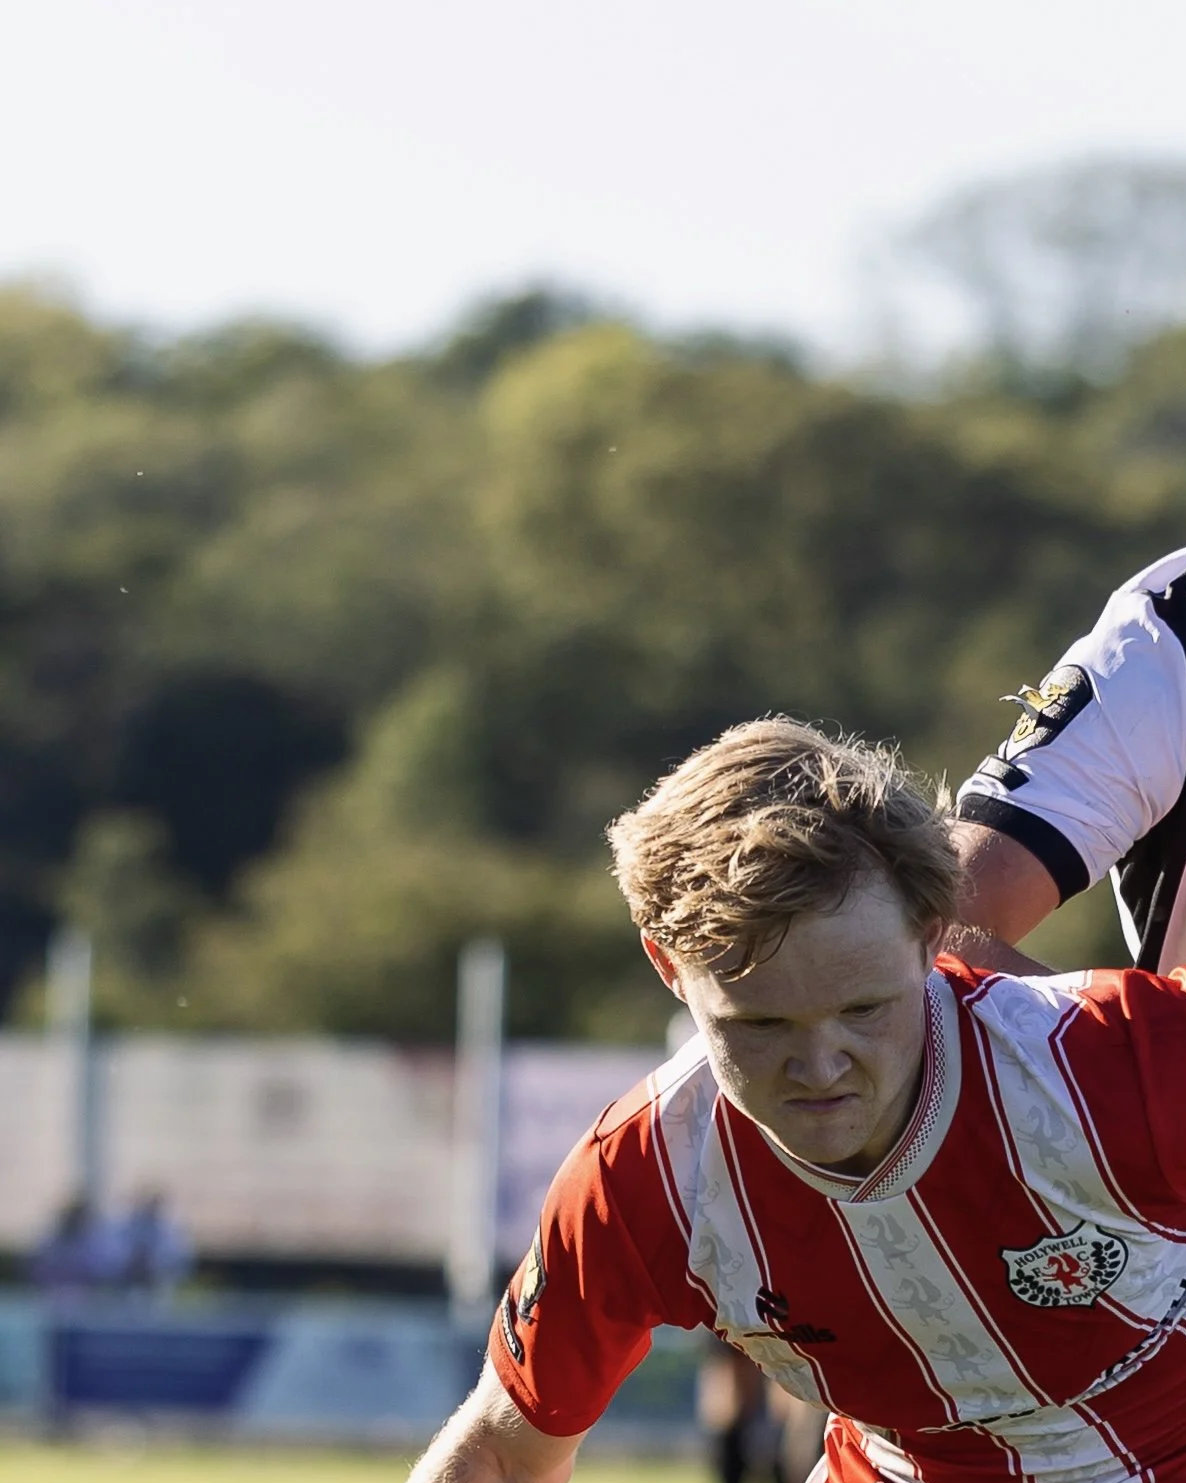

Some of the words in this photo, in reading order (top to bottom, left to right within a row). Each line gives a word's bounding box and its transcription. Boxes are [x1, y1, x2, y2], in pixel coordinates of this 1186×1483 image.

[1014, 1236, 1088, 1268] HOLYWELL
[1076, 1250, 1090, 1262] C
[1062, 1286, 1101, 1306] TOWN
